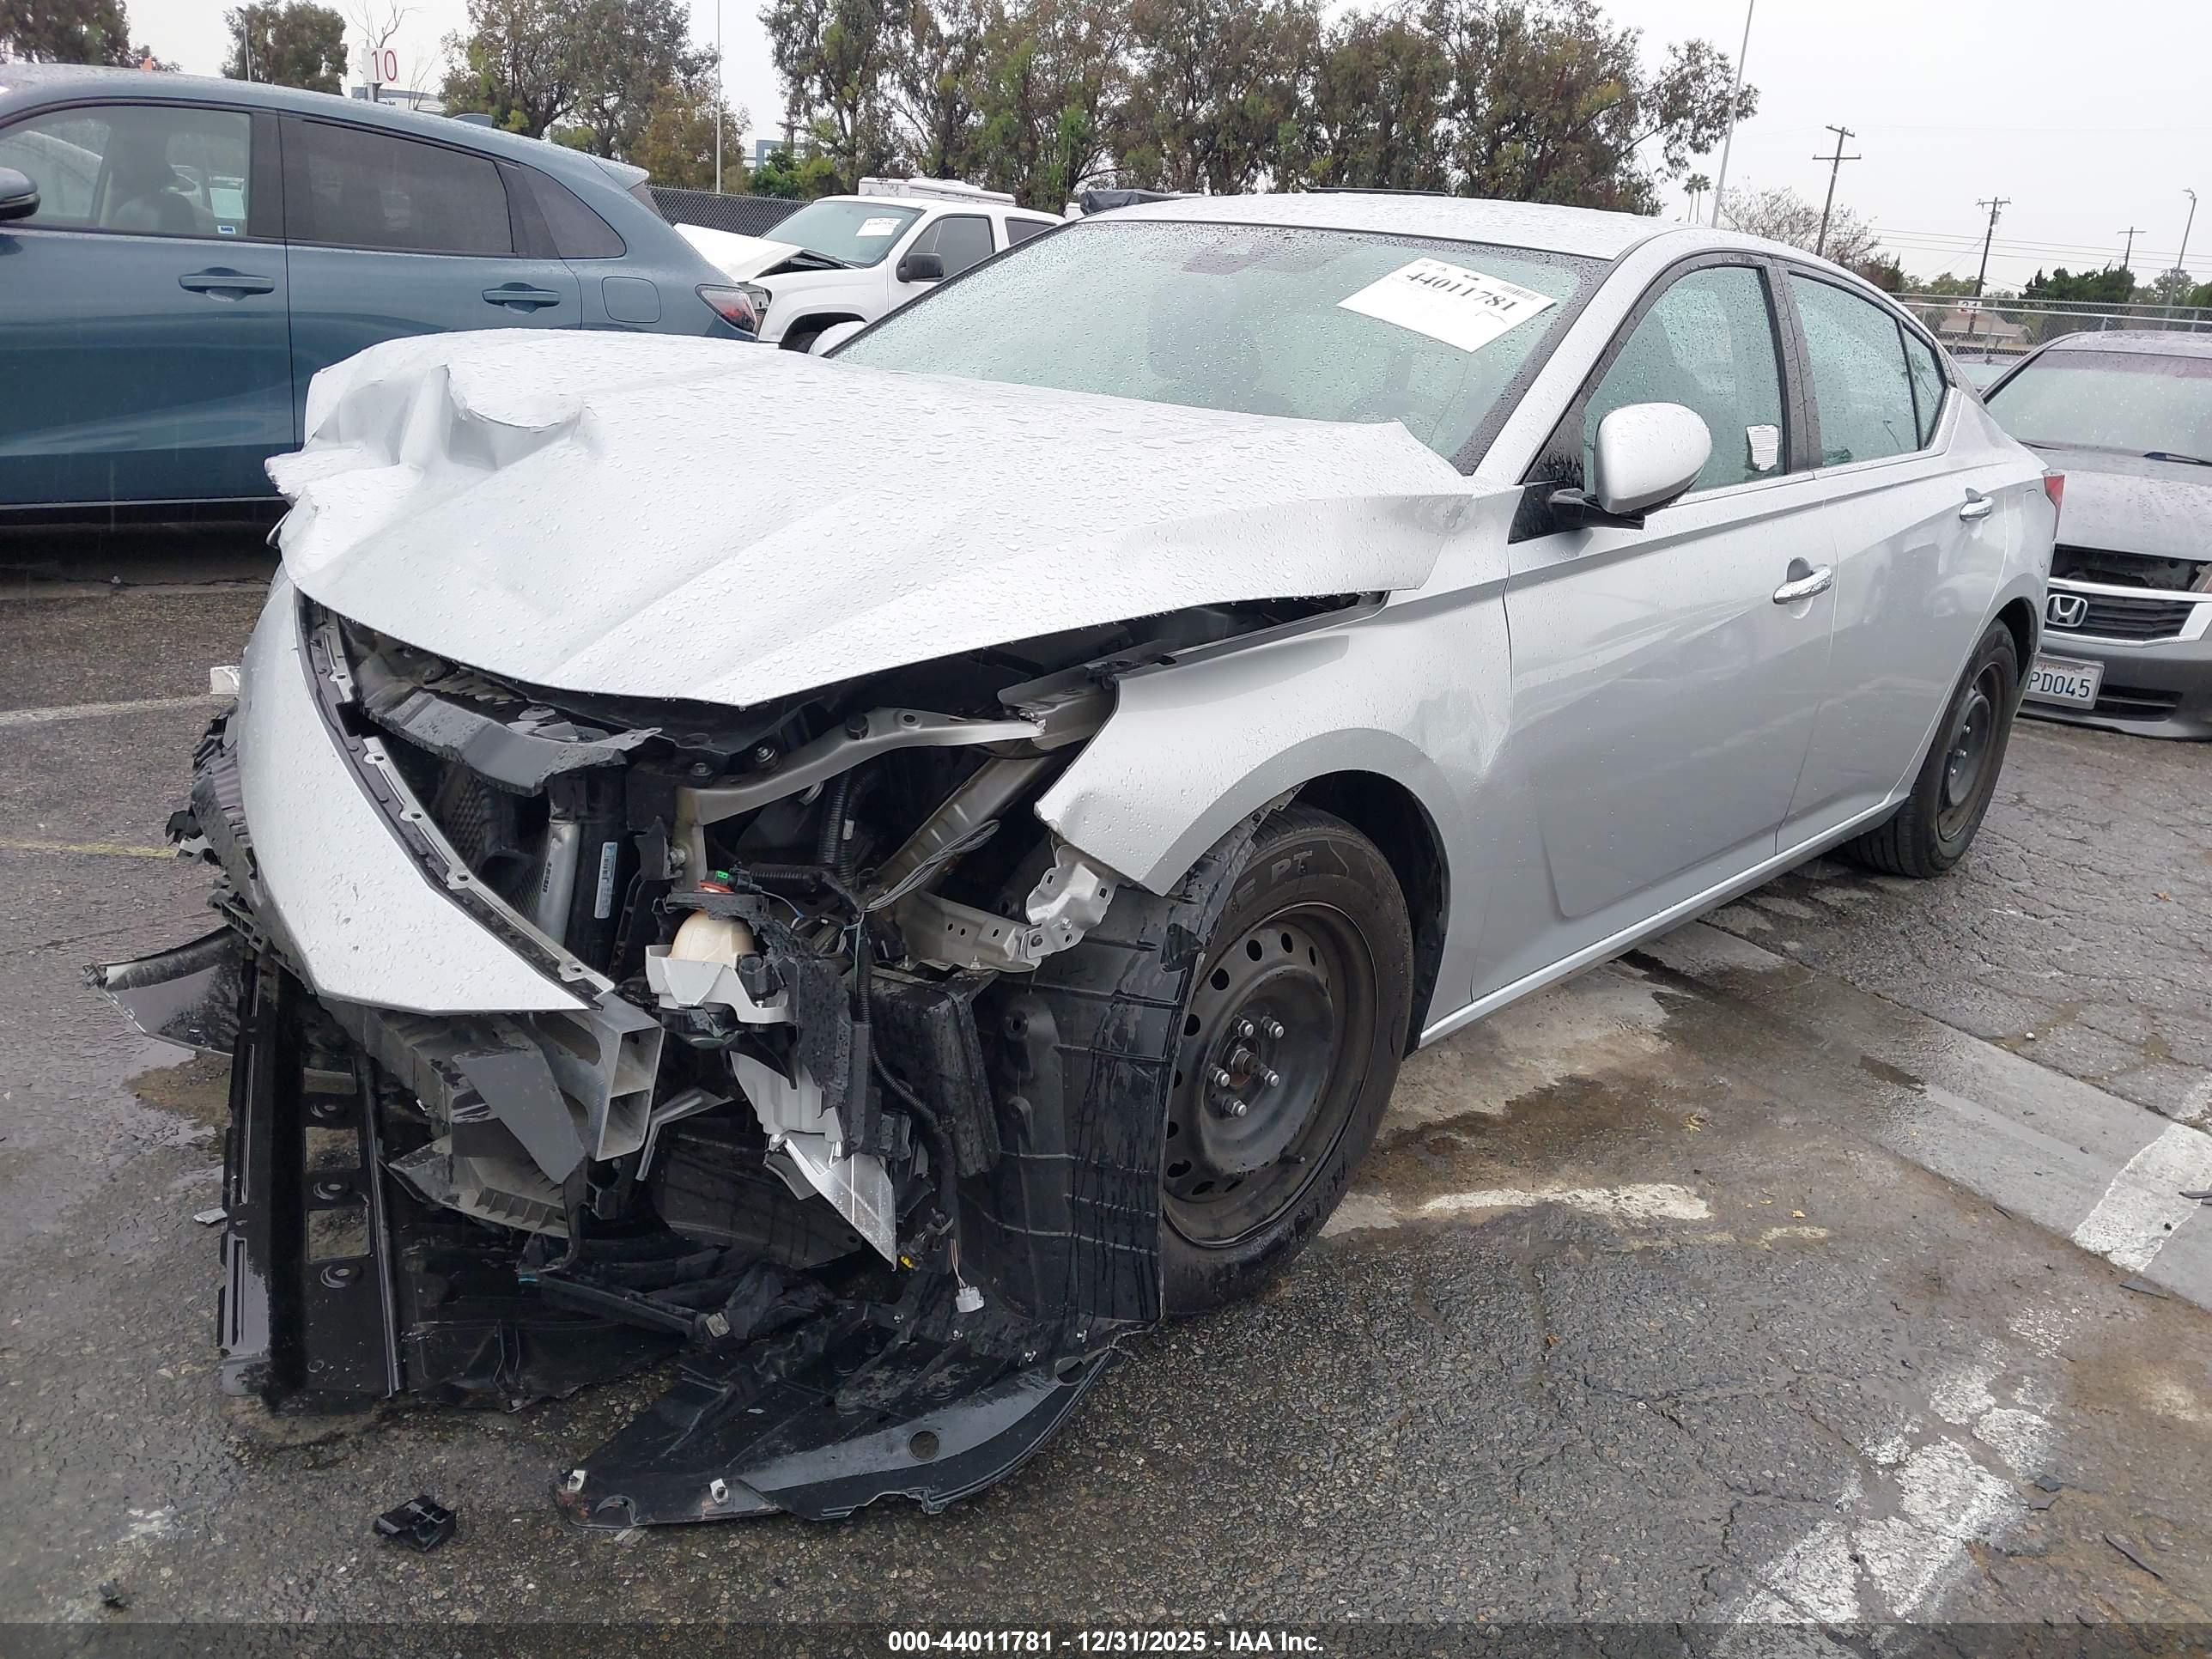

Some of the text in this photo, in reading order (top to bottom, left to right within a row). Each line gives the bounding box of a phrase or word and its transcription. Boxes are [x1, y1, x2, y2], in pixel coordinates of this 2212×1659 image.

[371, 49, 398, 82] 10
[1406, 270, 1519, 312] 44011781
[2027, 670, 2092, 698] PD045
